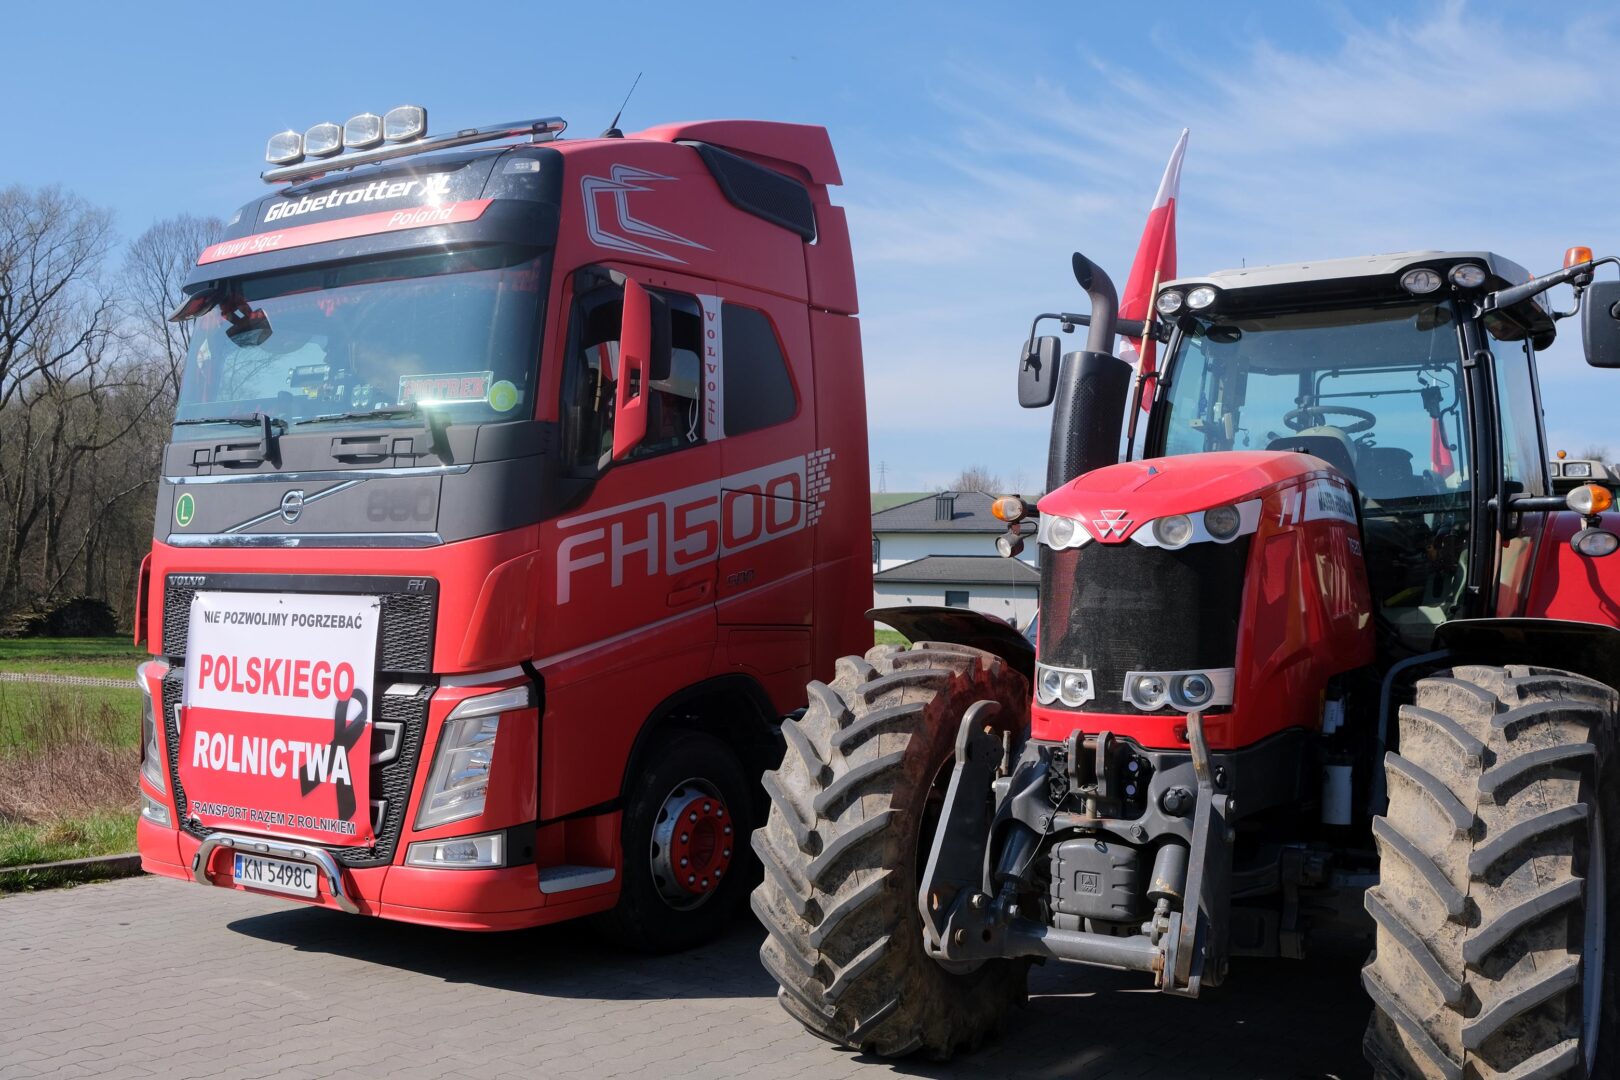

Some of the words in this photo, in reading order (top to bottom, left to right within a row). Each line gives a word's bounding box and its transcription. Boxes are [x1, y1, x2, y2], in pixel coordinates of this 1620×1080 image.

[263, 181, 418, 223] Globetrotter
[418, 174, 451, 197] XL
[388, 204, 457, 227] Poland
[211, 240, 251, 258] Nowy
[249, 233, 284, 252] Sącz
[706, 311, 717, 392] VOLVO
[708, 399, 716, 425] FH
[181, 500, 189, 520] L
[557, 472, 801, 605] FH500
[168, 576, 206, 586] VOLVO
[407, 579, 426, 591] FH
[204, 611, 221, 624] NIE
[223, 611, 288, 626] POZWOLIMY
[291, 612, 363, 629] POGRZEBAĆ
[199, 654, 355, 702] POLSKIEGO
[193, 731, 351, 785] ROLNICTWA
[250, 810, 285, 824] RAZEM
[288, 814, 294, 826] Z
[297, 815, 356, 834] ROLNIKIEM
[244, 858, 263, 881] KN
[268, 862, 312, 890] 5498C
